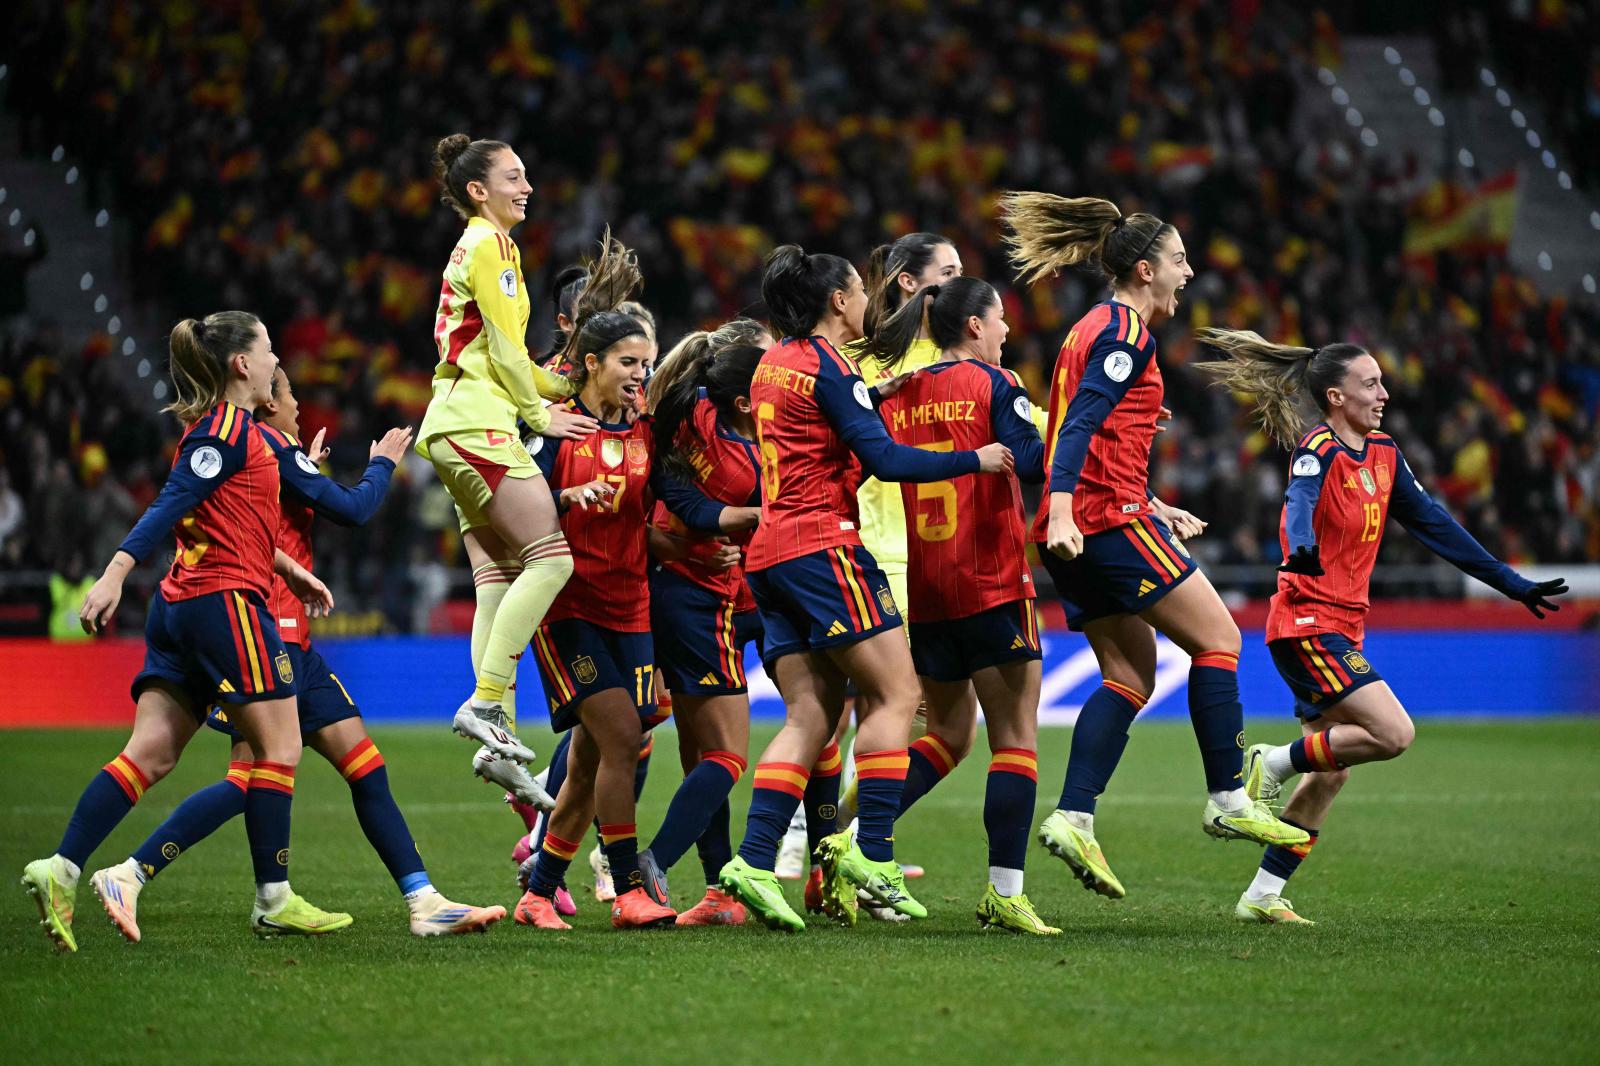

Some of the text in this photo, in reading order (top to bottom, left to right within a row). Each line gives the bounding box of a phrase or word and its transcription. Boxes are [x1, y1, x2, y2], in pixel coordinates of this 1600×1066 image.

[911, 399, 976, 426] MÉNDEZ
[757, 401, 780, 503] 6
[913, 440, 957, 542] 5
[1361, 502, 1381, 543] 19
[634, 663, 654, 707] 17
